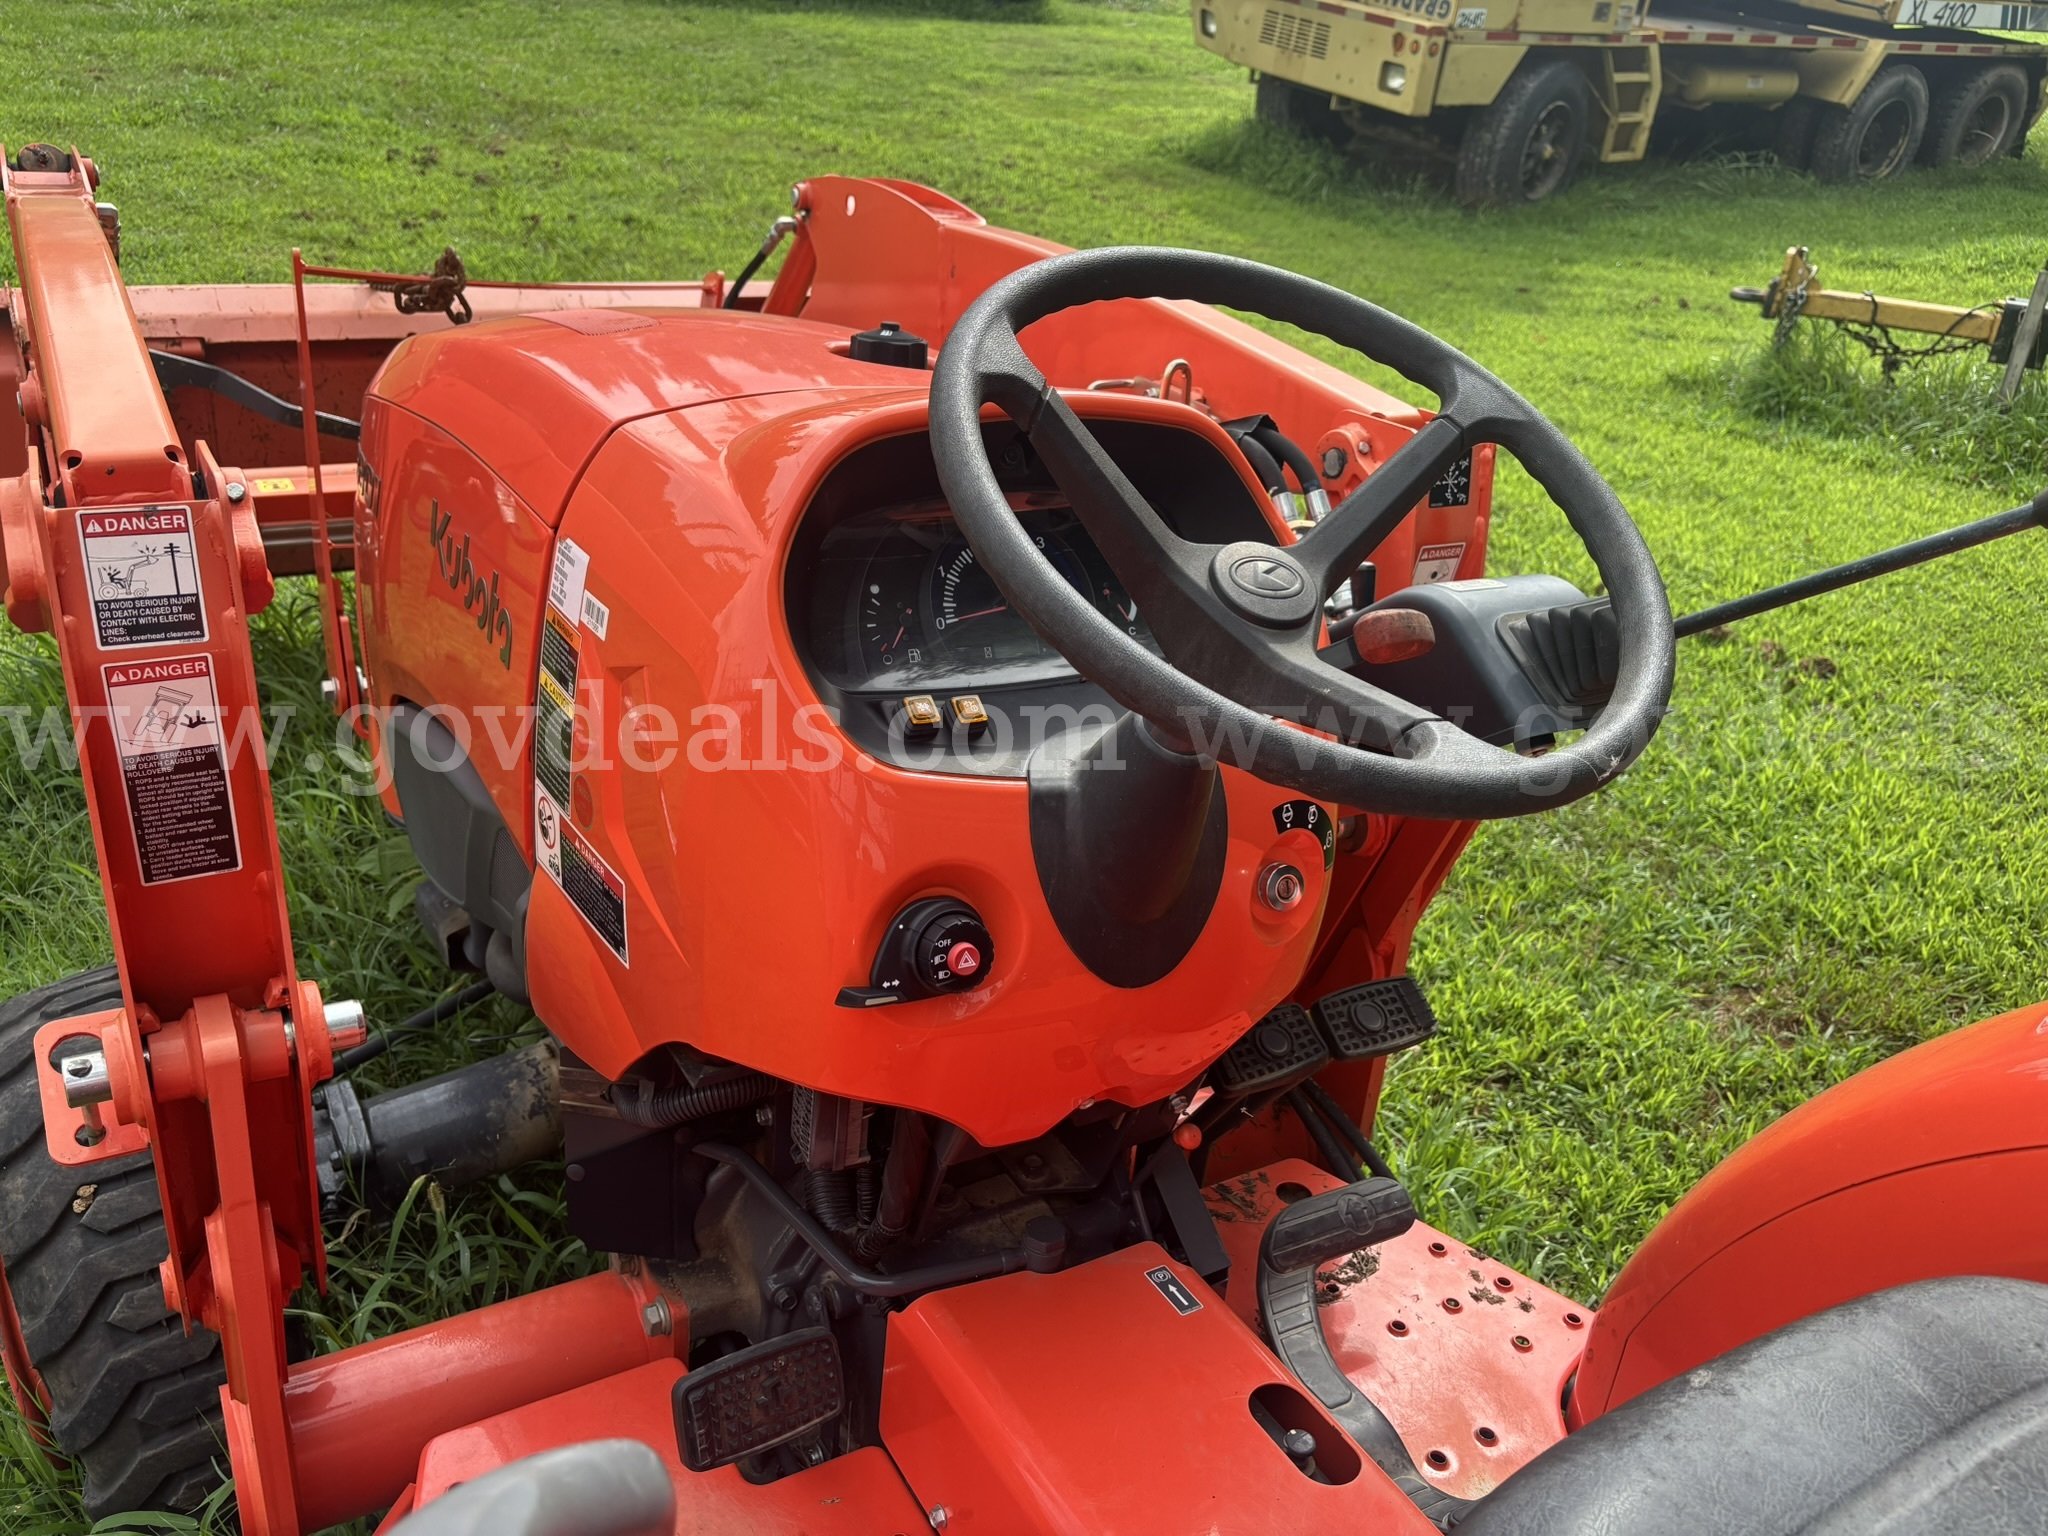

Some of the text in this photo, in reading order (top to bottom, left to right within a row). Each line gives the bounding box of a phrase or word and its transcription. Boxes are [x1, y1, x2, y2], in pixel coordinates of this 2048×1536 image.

[1933, 3, 1977, 27] 4100
[105, 515, 186, 532] DANGER
[1036, 536, 1045, 549] 3
[1428, 547, 1461, 559] DANGER
[937, 565, 945, 578] 1
[430, 497, 512, 671] Kubota
[111, 601, 133, 609] AVOID
[135, 598, 168, 607] SERIOUS
[170, 596, 196, 604] INJURY
[100, 611, 111, 619] OR
[113, 609, 138, 617] DEATH
[140, 607, 171, 615] CAUSED
[101, 619, 136, 627] CONTACT
[160, 613, 196, 622] ELECTRIC
[936, 617, 945, 630] 0
[102, 628, 127, 636] LINES:
[128, 661, 207, 681] DANGER
[136, 754, 158, 763] AVOID
[160, 749, 192, 759] SERIOUS
[193, 745, 219, 754] INJURY
[138, 761, 162, 769] DEATH
[164, 756, 194, 765] CAUSED
[127, 766, 174, 778] ROLLOVERS:
[581, 843, 605, 878] DANGER
[938, 938, 952, 948] OFF
